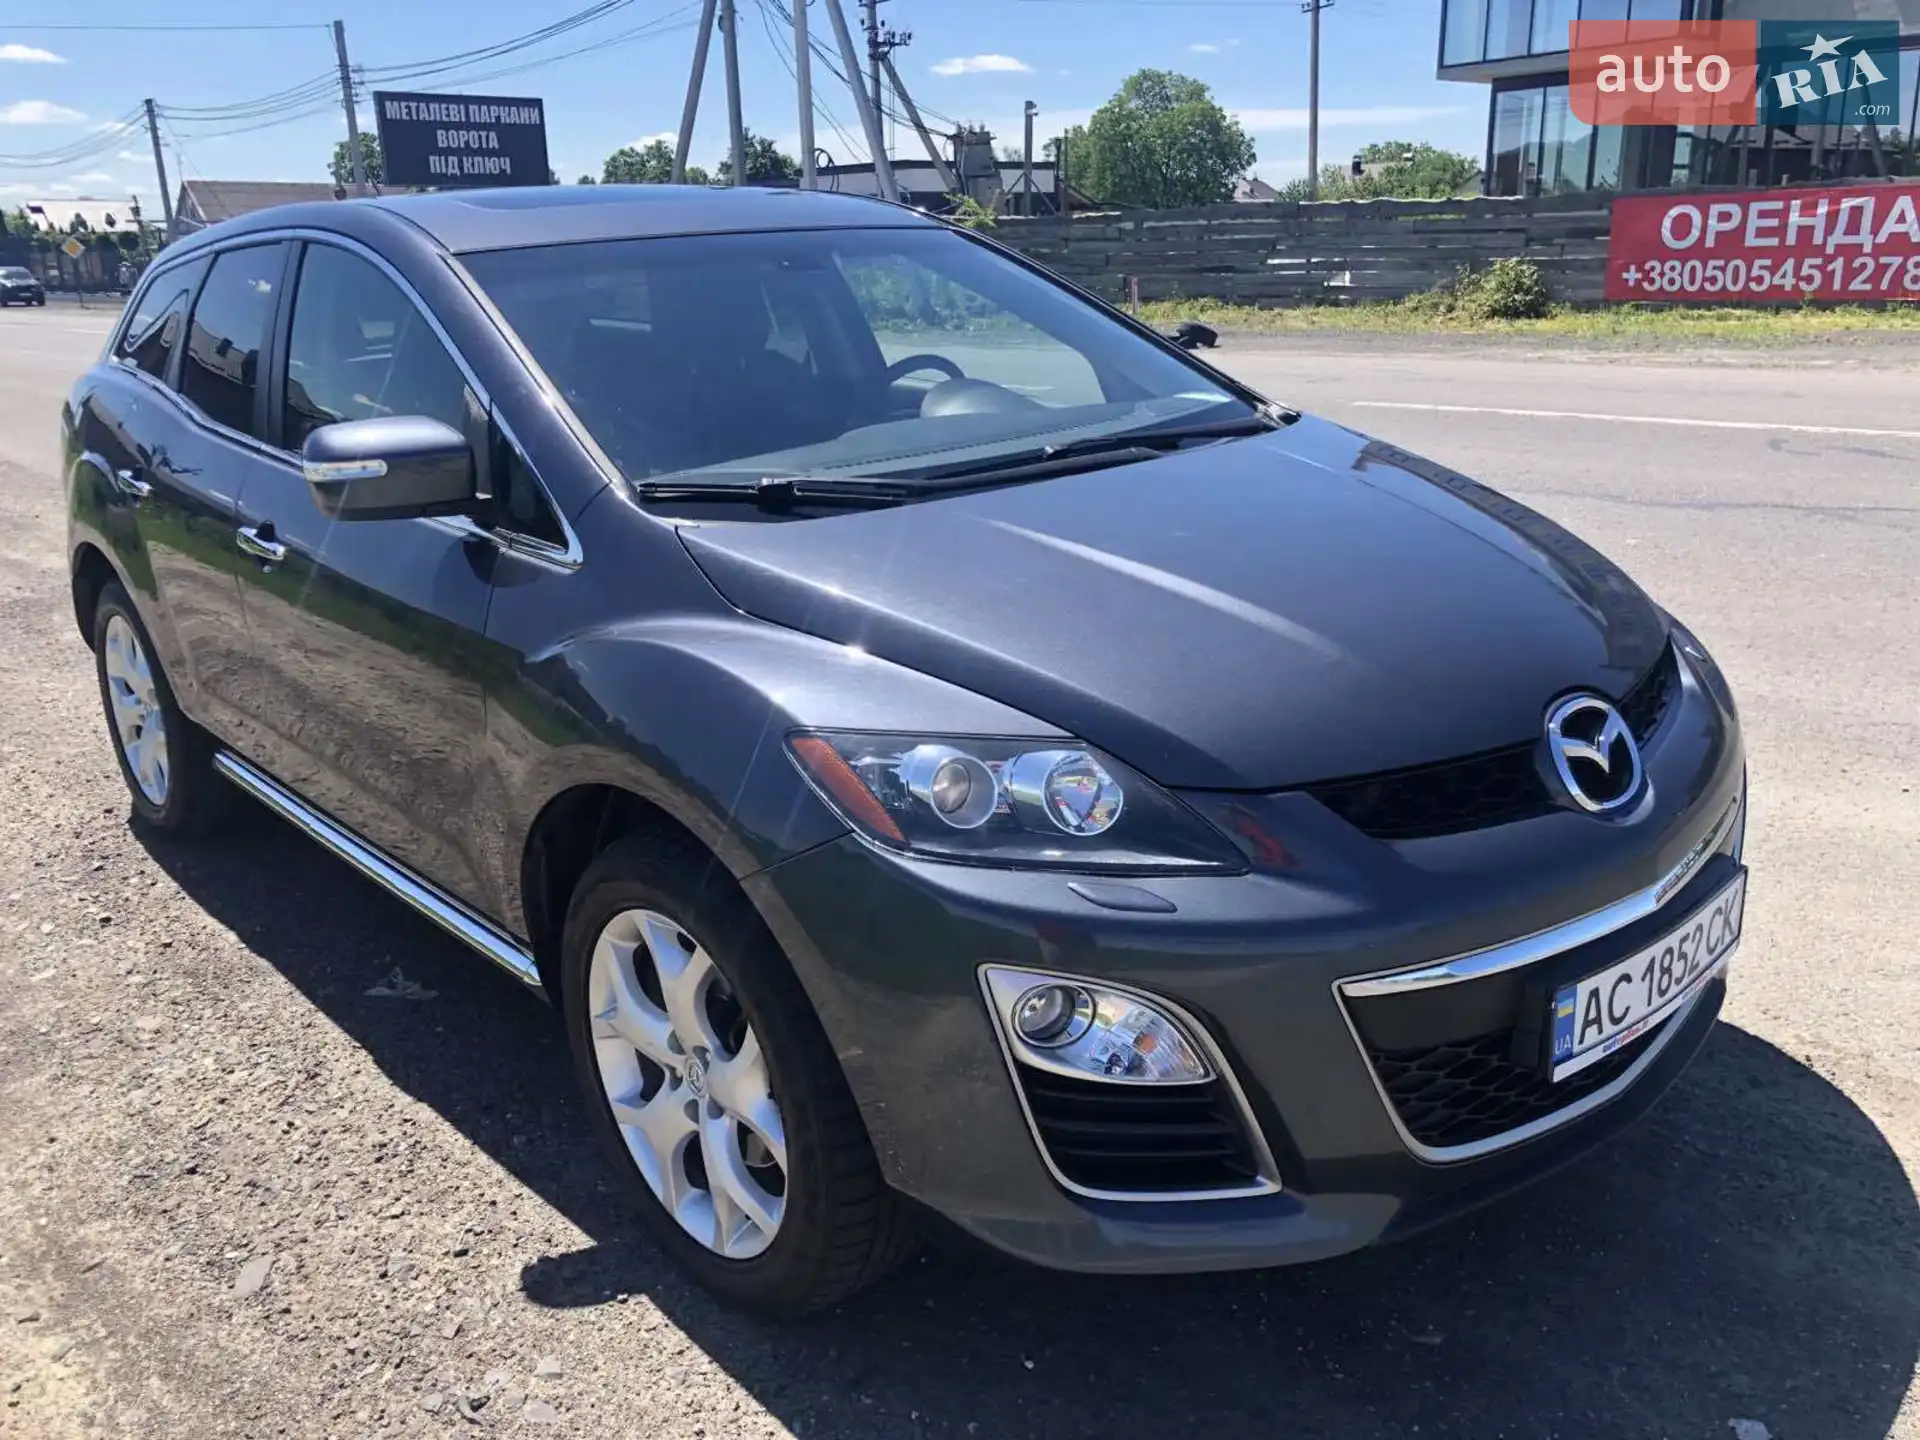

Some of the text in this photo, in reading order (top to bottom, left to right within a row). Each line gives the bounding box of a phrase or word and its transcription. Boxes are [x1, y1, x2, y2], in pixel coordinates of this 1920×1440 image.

[385, 100, 541, 124] МЕТАЛЕВІ ПАРКАНИ
[436, 129, 499, 149] ВОРОТА
[428, 155, 512, 176] ПІД КЛЮЧ
[1661, 195, 1920, 254] ОРЕНДА
[1554, 1036, 1572, 1056] UA
